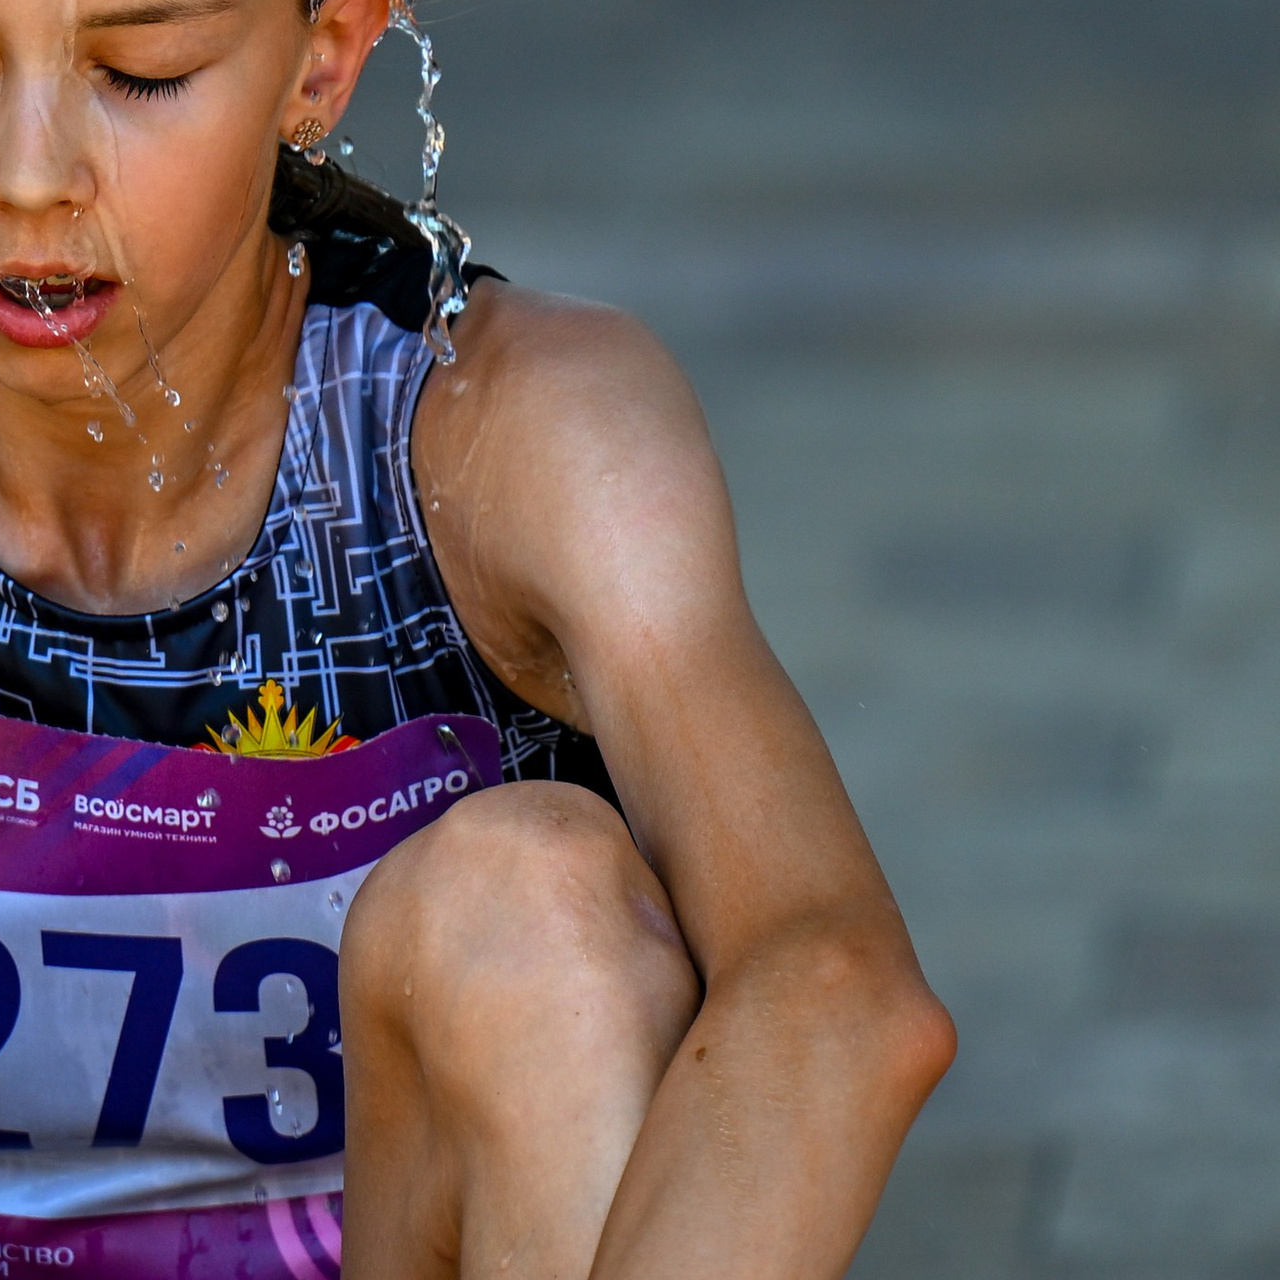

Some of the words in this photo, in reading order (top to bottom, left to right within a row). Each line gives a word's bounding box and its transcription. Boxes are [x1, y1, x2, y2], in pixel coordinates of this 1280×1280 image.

[308, 769, 470, 836] ФОСАГРО
[73, 820, 122, 837] МАГАЗИН
[123, 828, 163, 841] УМНОЙ
[165, 832, 218, 844] ТЕХНИКИ
